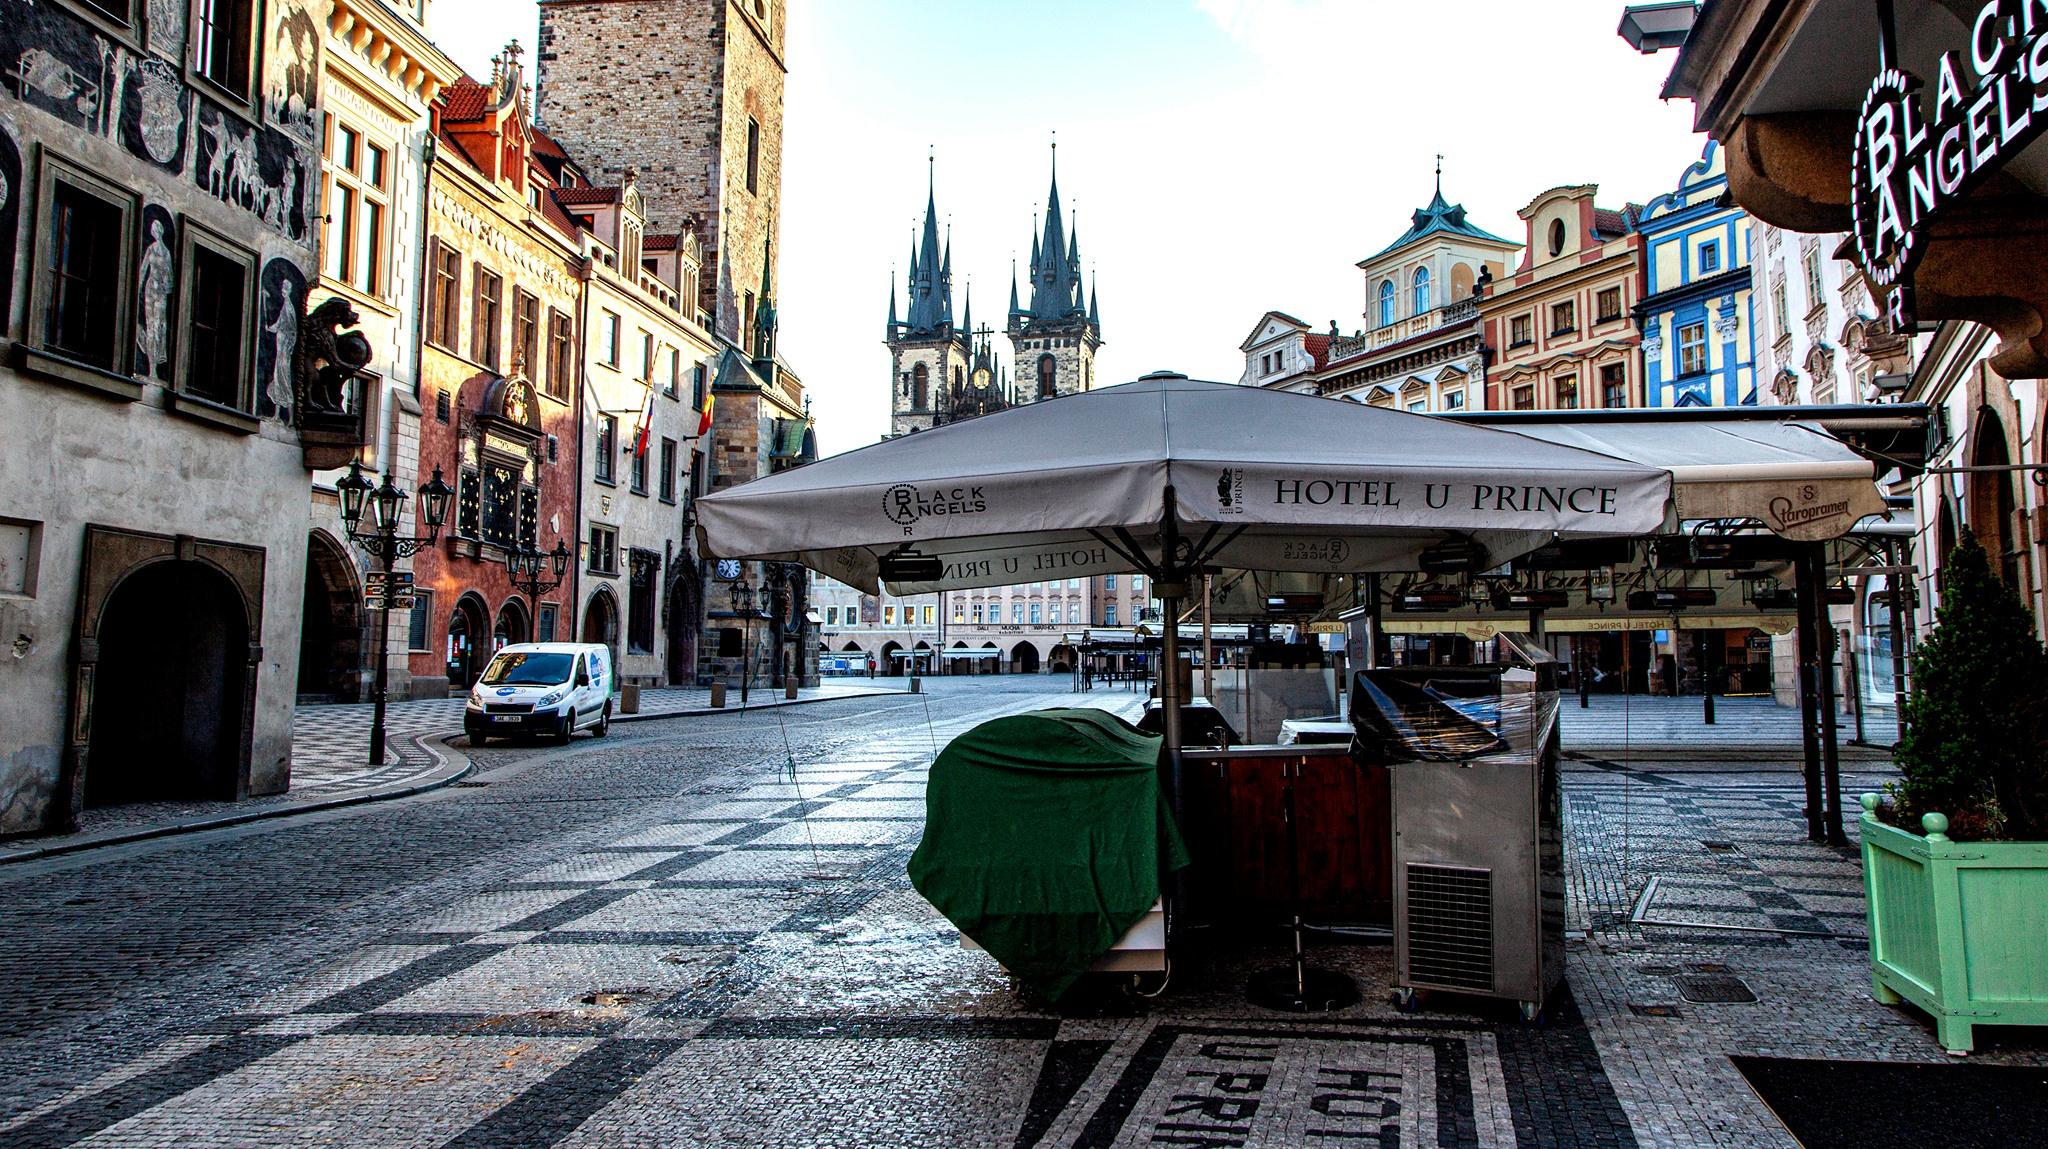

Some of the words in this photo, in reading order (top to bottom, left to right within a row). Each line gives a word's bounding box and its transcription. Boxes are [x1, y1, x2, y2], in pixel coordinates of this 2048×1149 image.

[1886, 286, 1906, 335] R
[894, 486, 985, 506] BLACK
[1235, 468, 1243, 505] PRINCE
[1274, 480, 1401, 510] HOTEL
[1425, 484, 1452, 510] U
[1472, 484, 1618, 516] PRINCE
[897, 500, 987, 520] ANGEL'S
[1769, 497, 1852, 533] Staropramen
[903, 526, 913, 536] R
[1150, 1071, 1270, 1149] PRI
